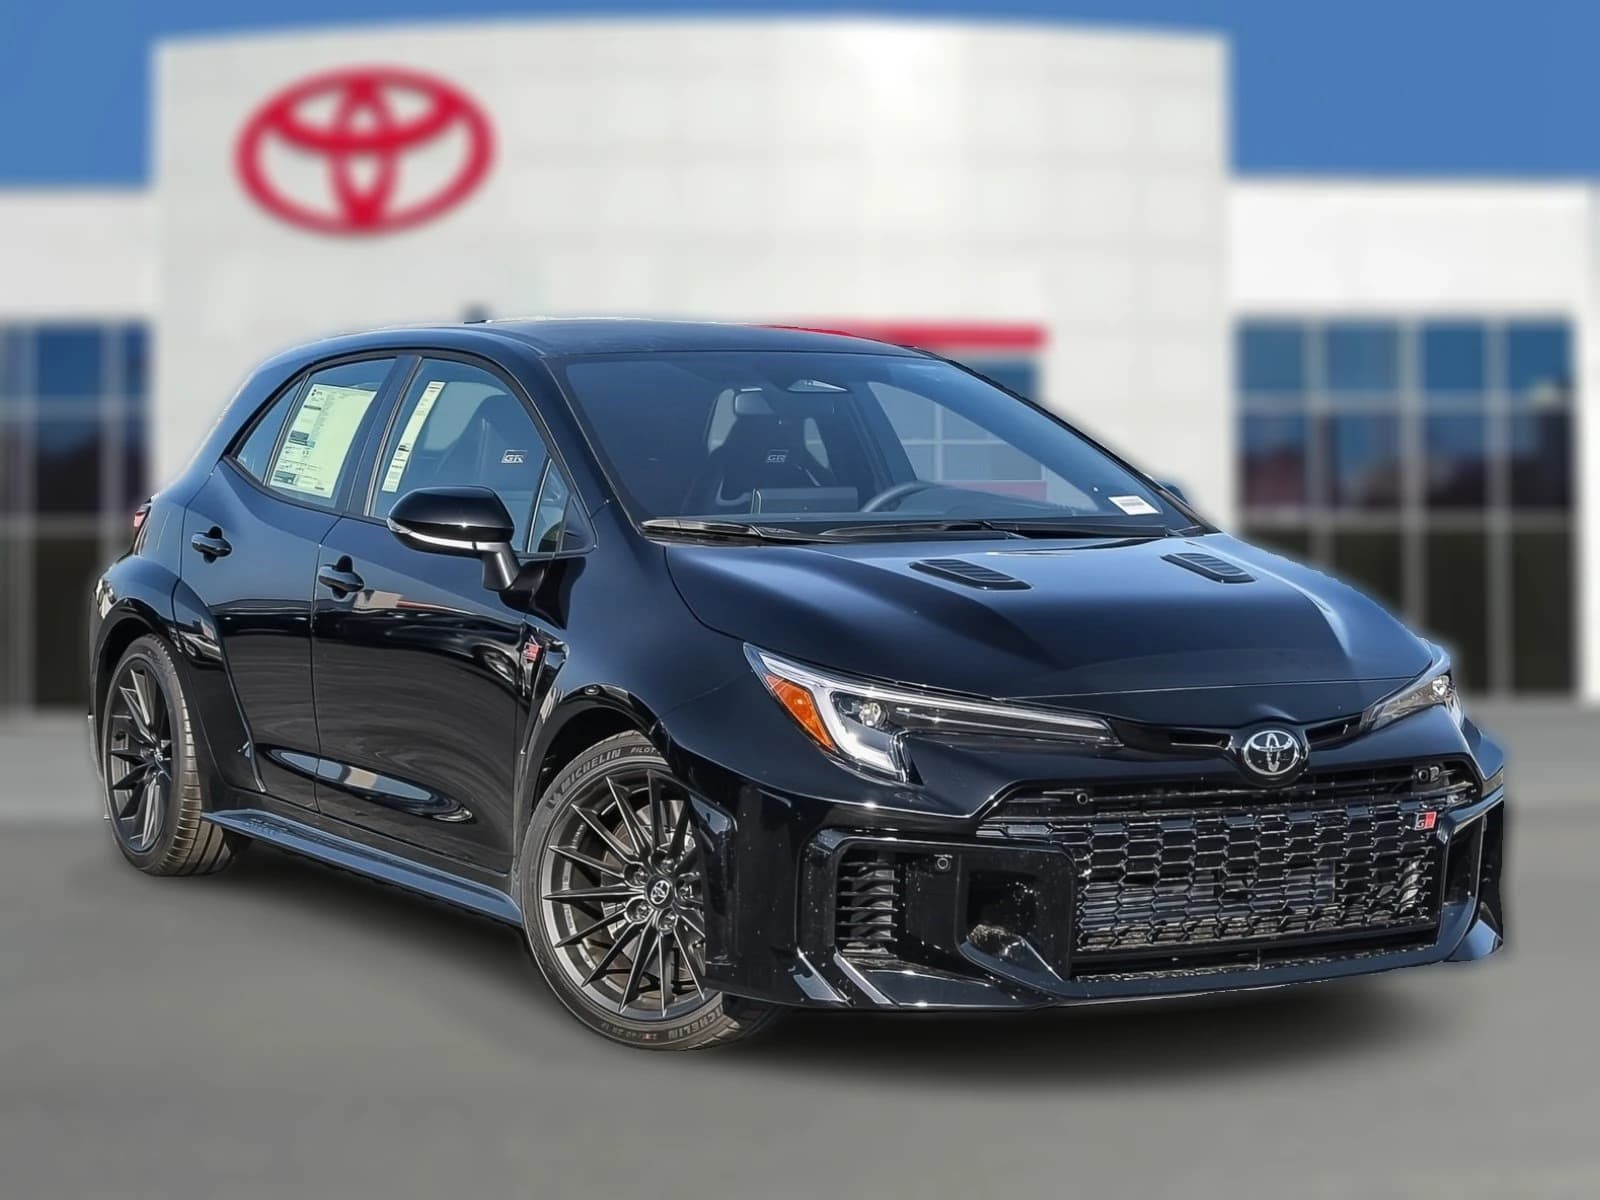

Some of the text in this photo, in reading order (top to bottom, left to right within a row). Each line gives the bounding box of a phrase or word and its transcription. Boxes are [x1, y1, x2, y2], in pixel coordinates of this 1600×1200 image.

[767, 453, 785, 463] GR
[561, 749, 621, 793] MICHELIN
[668, 1005, 722, 1039] ICHELIN
